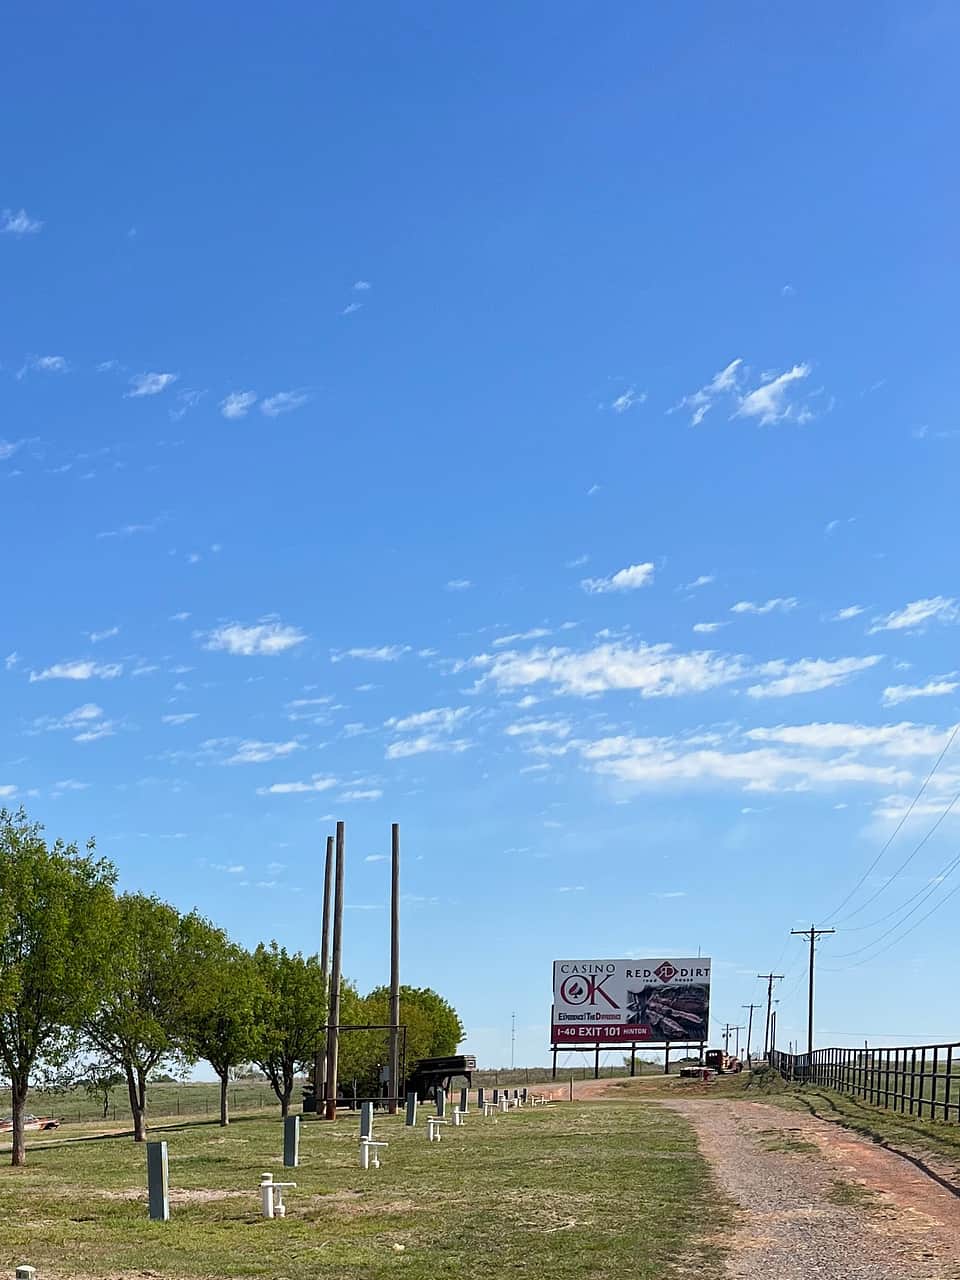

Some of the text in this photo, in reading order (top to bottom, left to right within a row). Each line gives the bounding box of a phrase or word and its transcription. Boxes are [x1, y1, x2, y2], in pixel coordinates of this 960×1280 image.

[560, 964, 616, 974] CASINO
[626, 969, 652, 978] RED
[680, 968, 710, 977] DIRT
[560, 974, 621, 1010] OK
[557, 1026, 648, 1037] I-40 EXIT 101 HINTON
